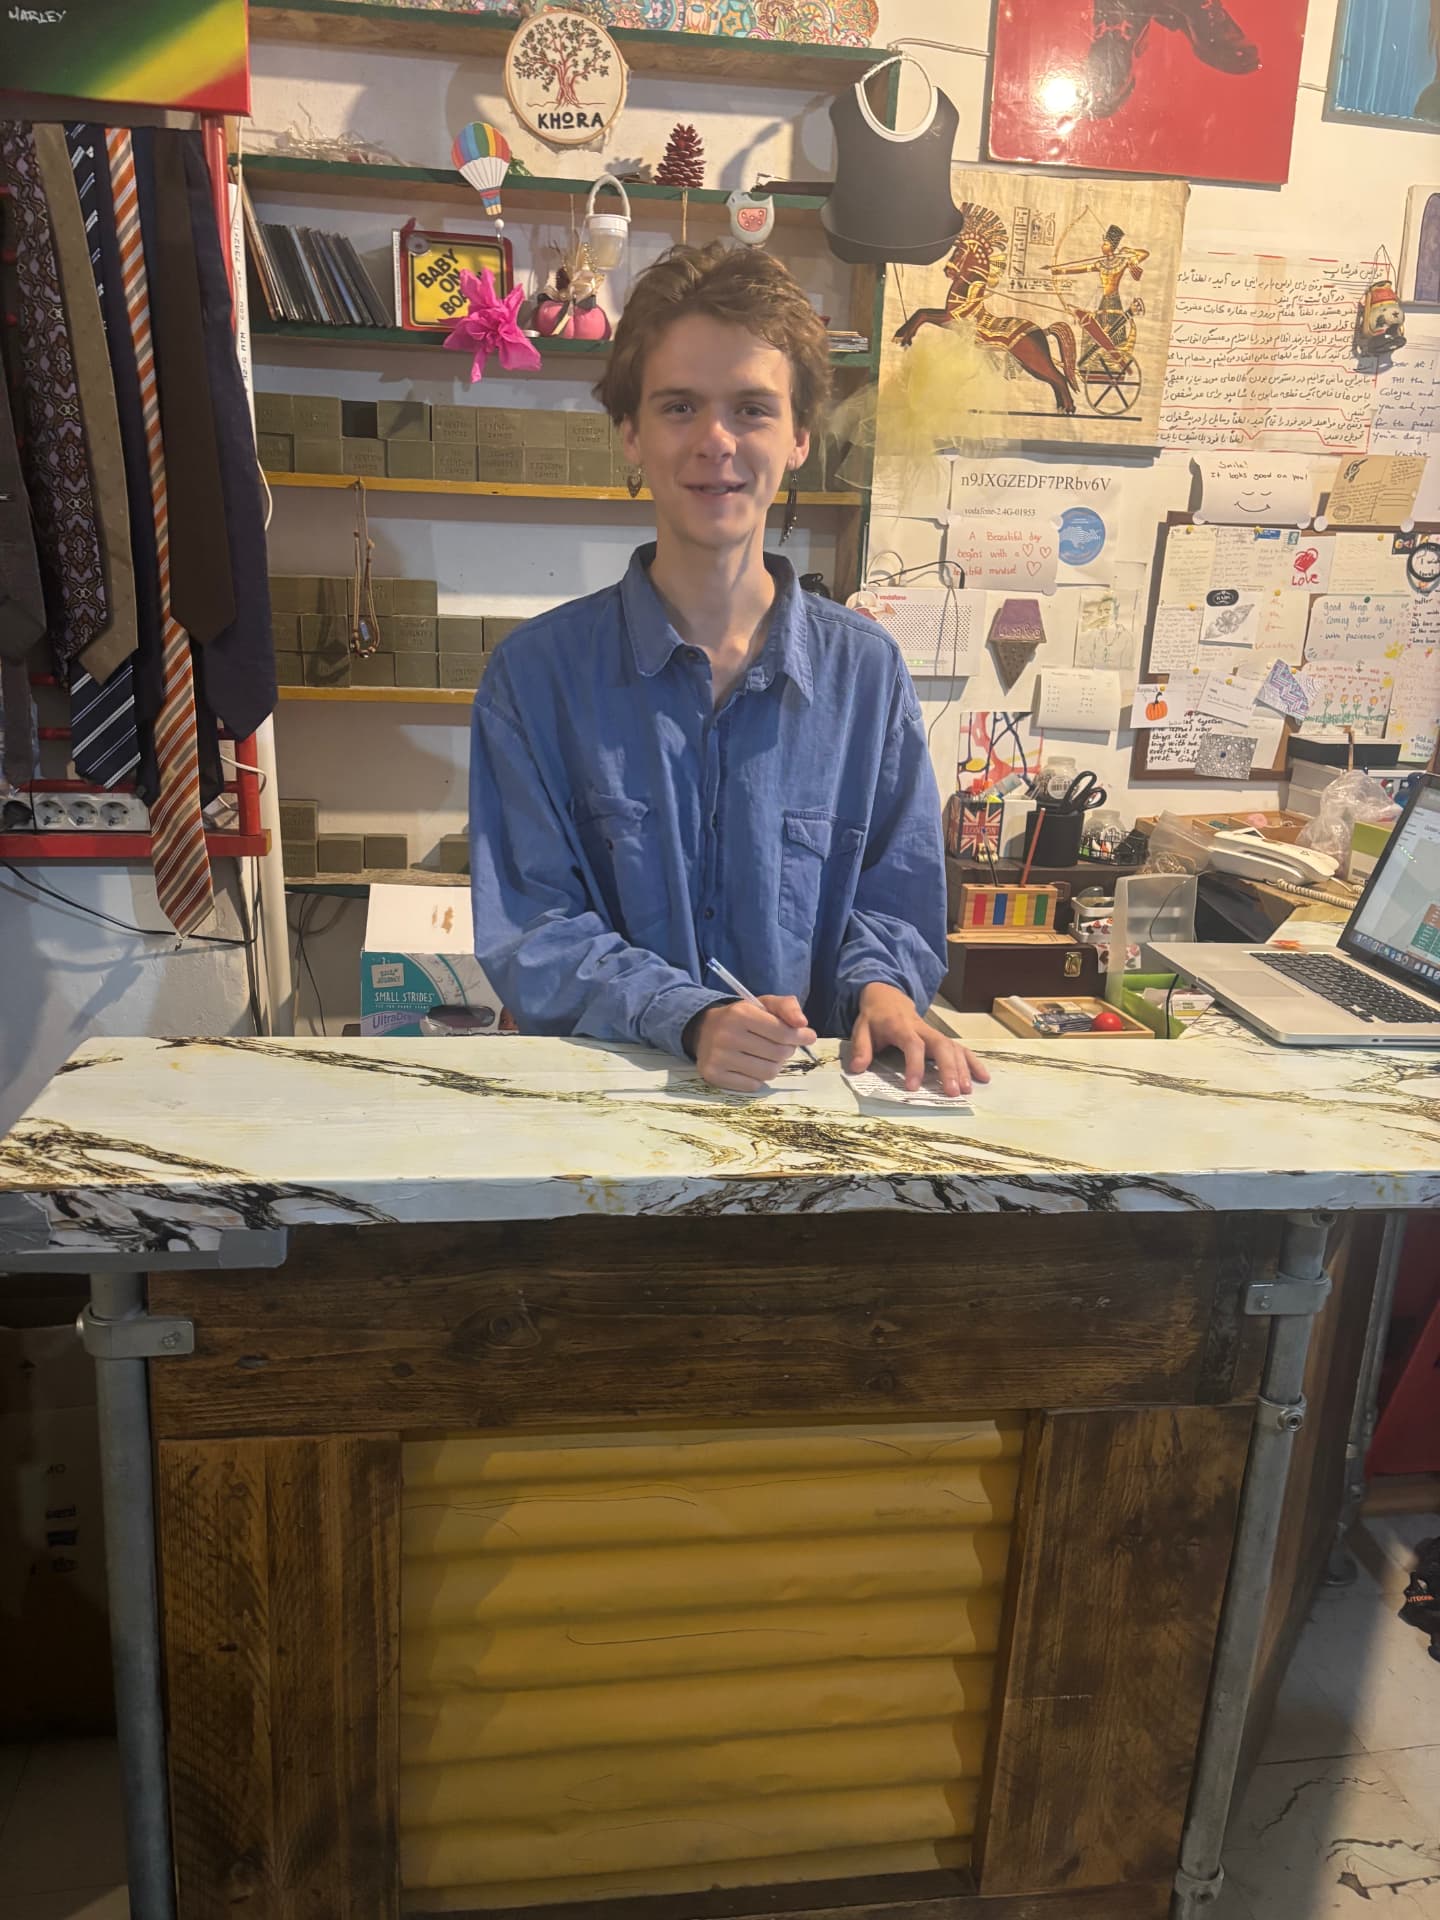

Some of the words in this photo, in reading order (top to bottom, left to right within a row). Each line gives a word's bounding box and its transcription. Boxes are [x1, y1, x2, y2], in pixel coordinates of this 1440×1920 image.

[8, 5, 67, 23] MARLEY
[538, 111, 605, 129] KHORA
[416, 248, 459, 288] BABY
[1218, 460, 1248, 469] Smile!
[1229, 472, 1248, 480] looks
[1252, 471, 1272, 480] good
[1291, 472, 1308, 480] you!
[969, 531, 976, 540] A
[986, 531, 1022, 541] Beautiful
[1029, 531, 1042, 542] day
[957, 548, 982, 560] begins
[990, 548, 1007, 558] with
[374, 992, 400, 1002] SMALL
